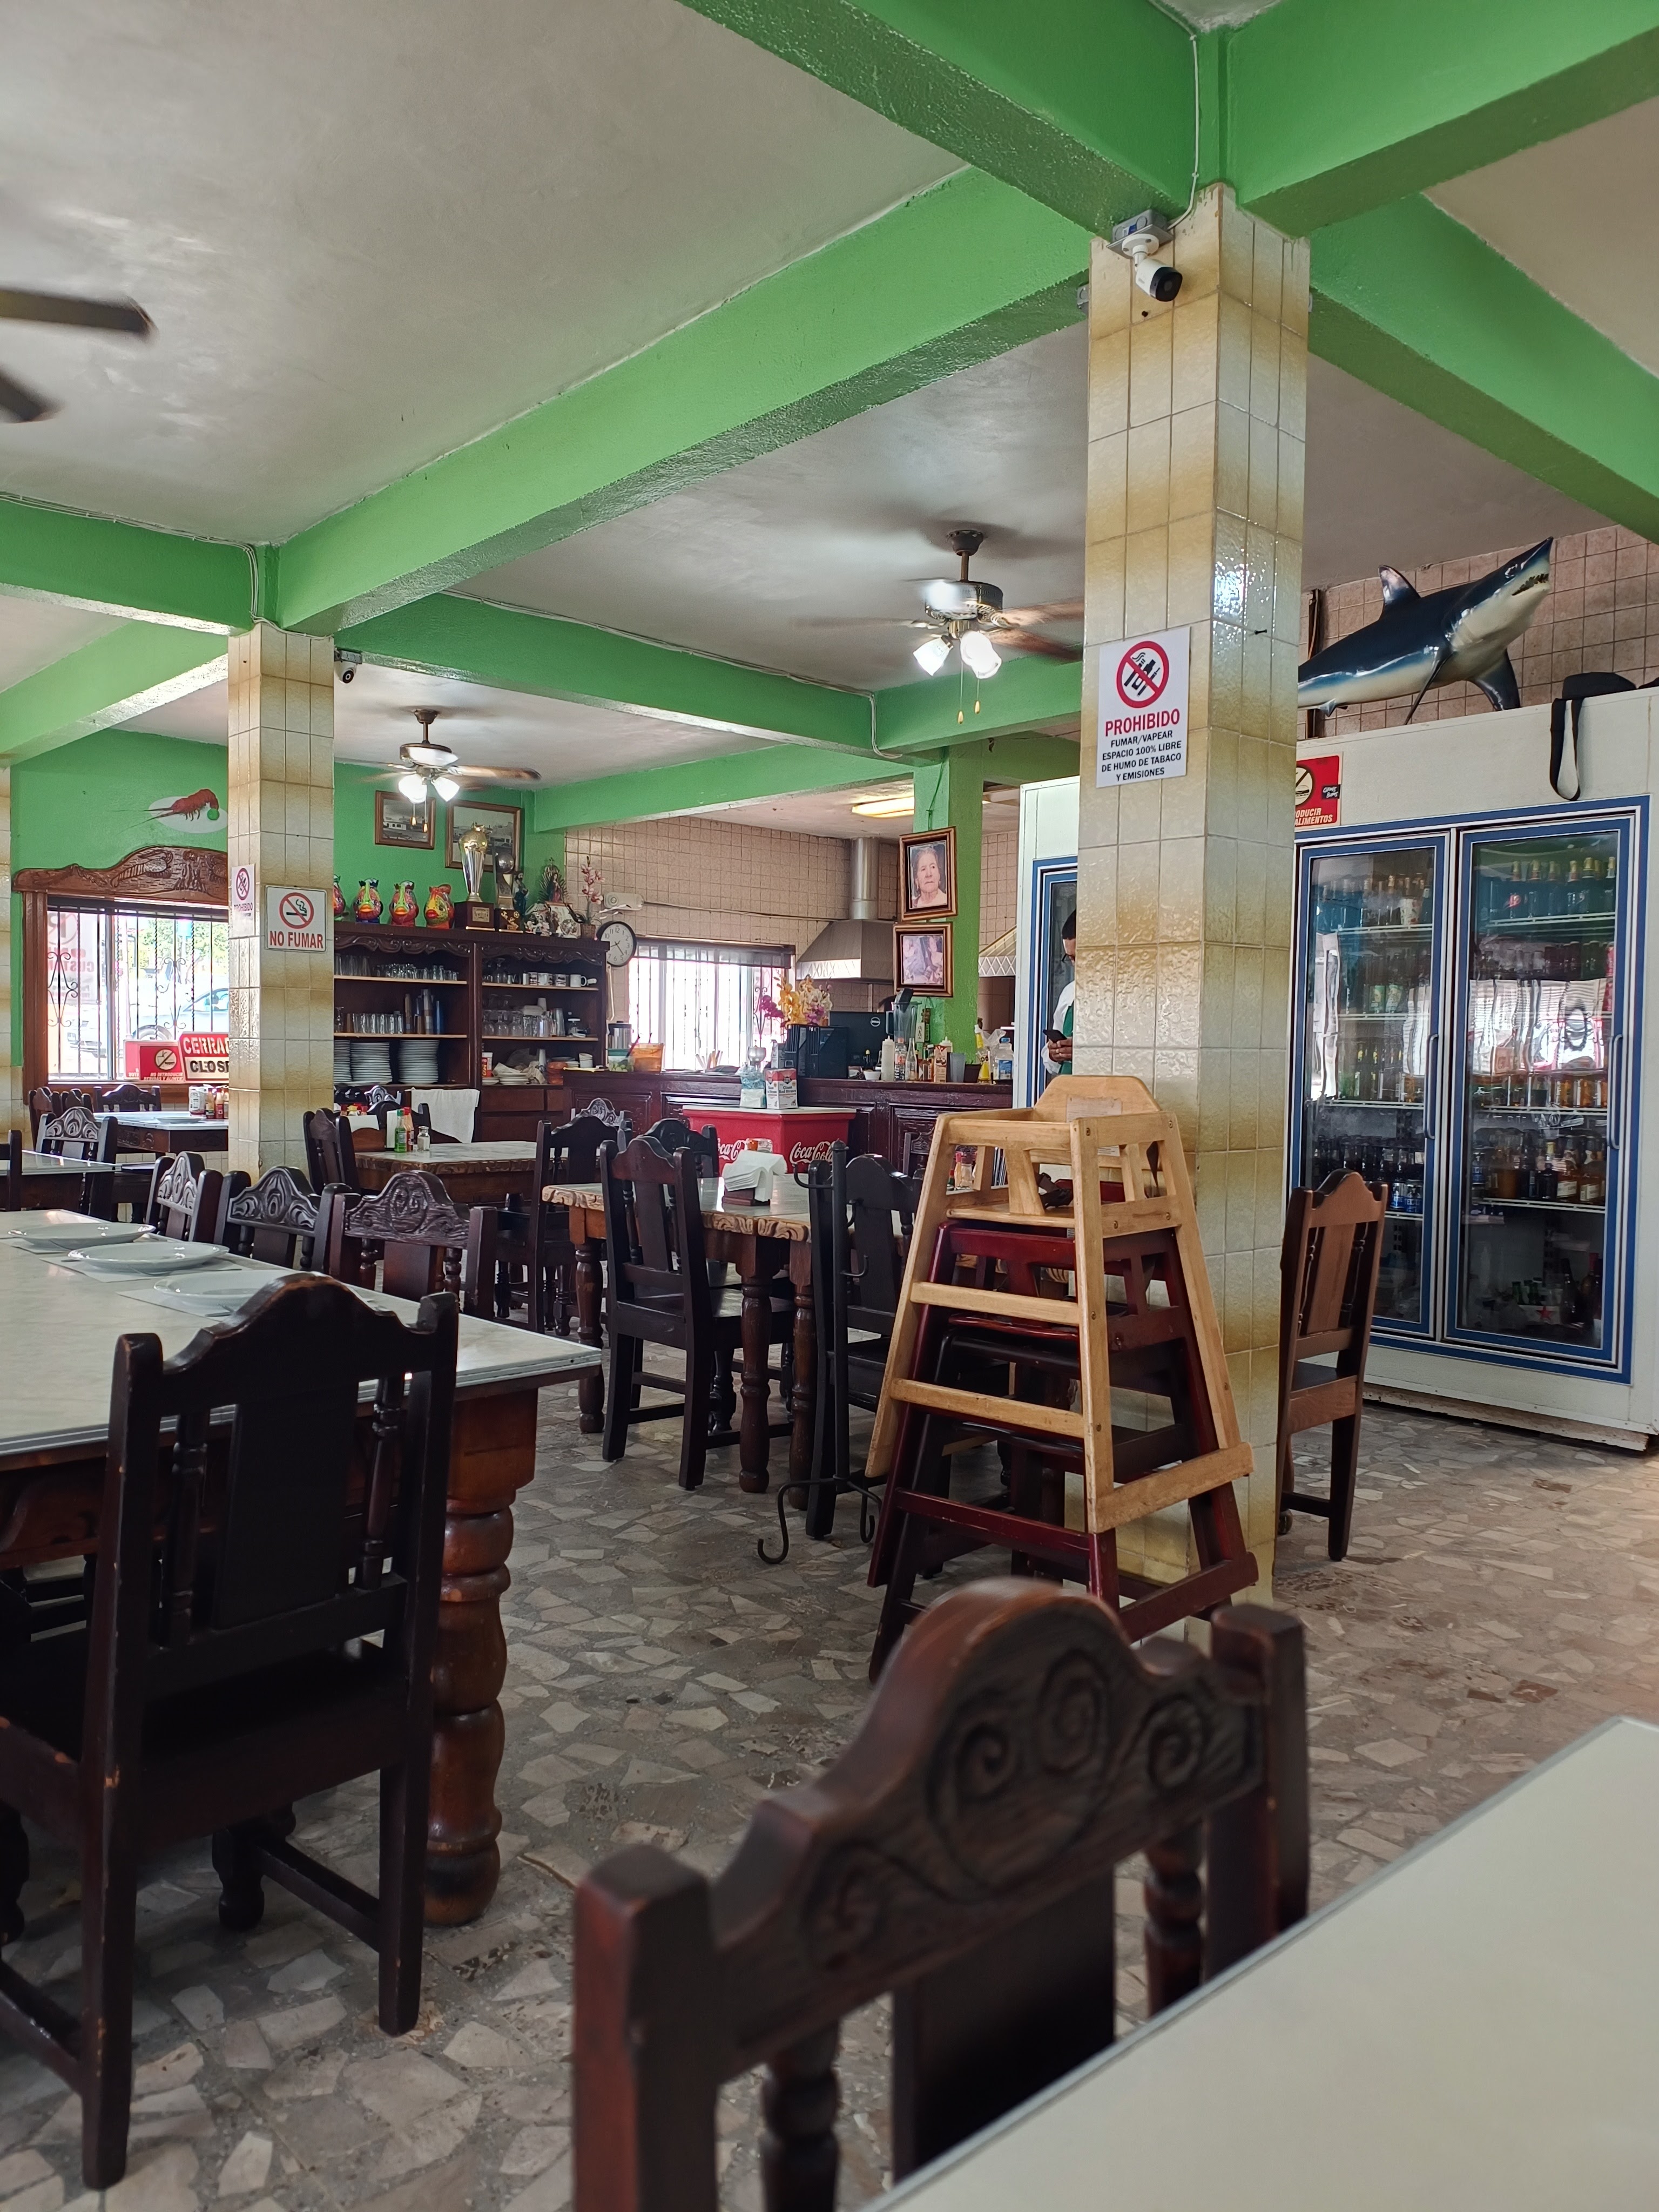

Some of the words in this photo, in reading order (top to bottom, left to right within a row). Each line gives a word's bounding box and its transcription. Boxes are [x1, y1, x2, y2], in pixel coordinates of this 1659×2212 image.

[1105, 709, 1180, 737] PROHIBIDO
[1111, 730, 1173, 748] FUMAR/VAPEAR
[1102, 748, 1134, 760] ESPACIO
[1136, 745, 1156, 756] 100%
[1158, 740, 1182, 751] LIBRE
[1102, 764, 1111, 772] DE
[1114, 760, 1136, 771] HUMO
[1138, 758, 1149, 766] DE
[1151, 753, 1181, 764] TABACO
[1123, 767, 1165, 780] EMISIONES
[1294, 808, 1321, 818] ODUCIR
[270, 930, 284, 946] NO
[288, 932, 323, 949] FUMAR
[190, 1060, 229, 1073] CLOS
